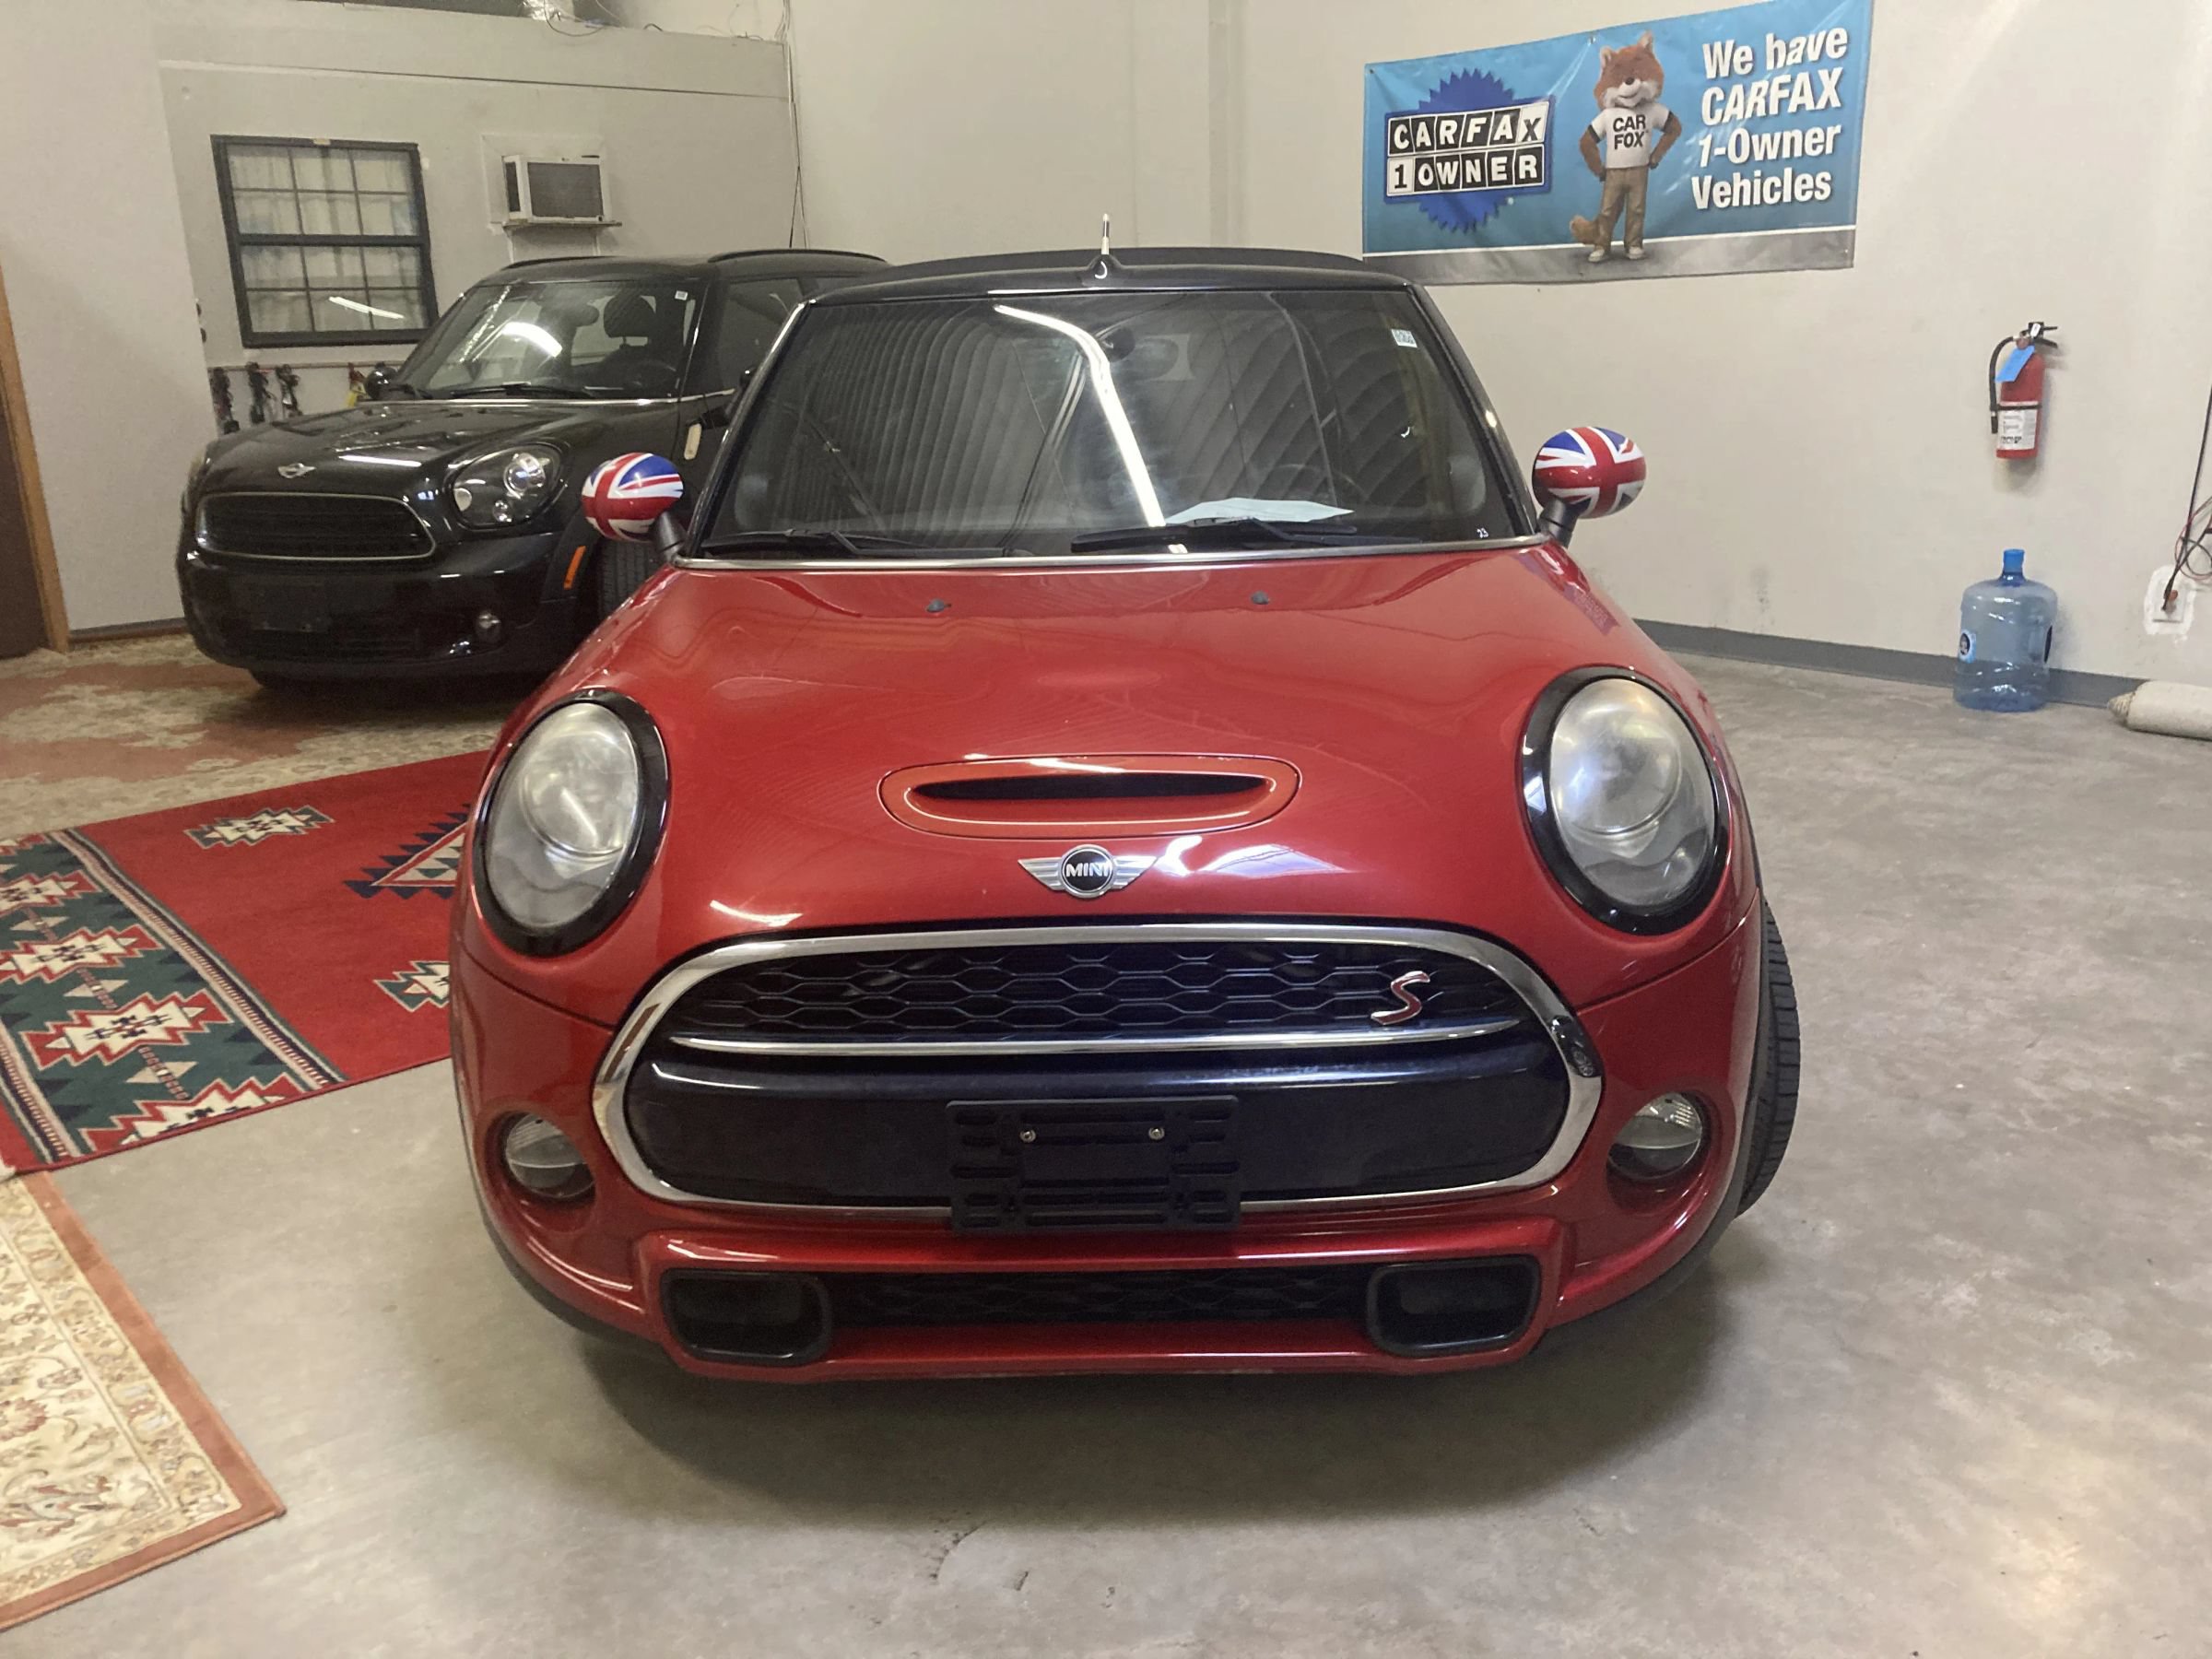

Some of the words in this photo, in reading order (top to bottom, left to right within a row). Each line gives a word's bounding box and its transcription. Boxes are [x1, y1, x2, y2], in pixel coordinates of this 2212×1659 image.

[1702, 40, 1754, 79] We
[1765, 27, 1848, 71] have
[1701, 67, 1843, 126] CARFAX
[1394, 114, 1542, 149] CARFAX
[1613, 114, 1646, 132] CAR
[1615, 131, 1644, 150] FOX
[1699, 124, 1841, 168] 1-Owner
[1418, 154, 1538, 186] OWNER
[1691, 167, 1832, 209] Vehicles
[1065, 862, 1112, 877] MINI
[1371, 971, 1430, 1026] S
